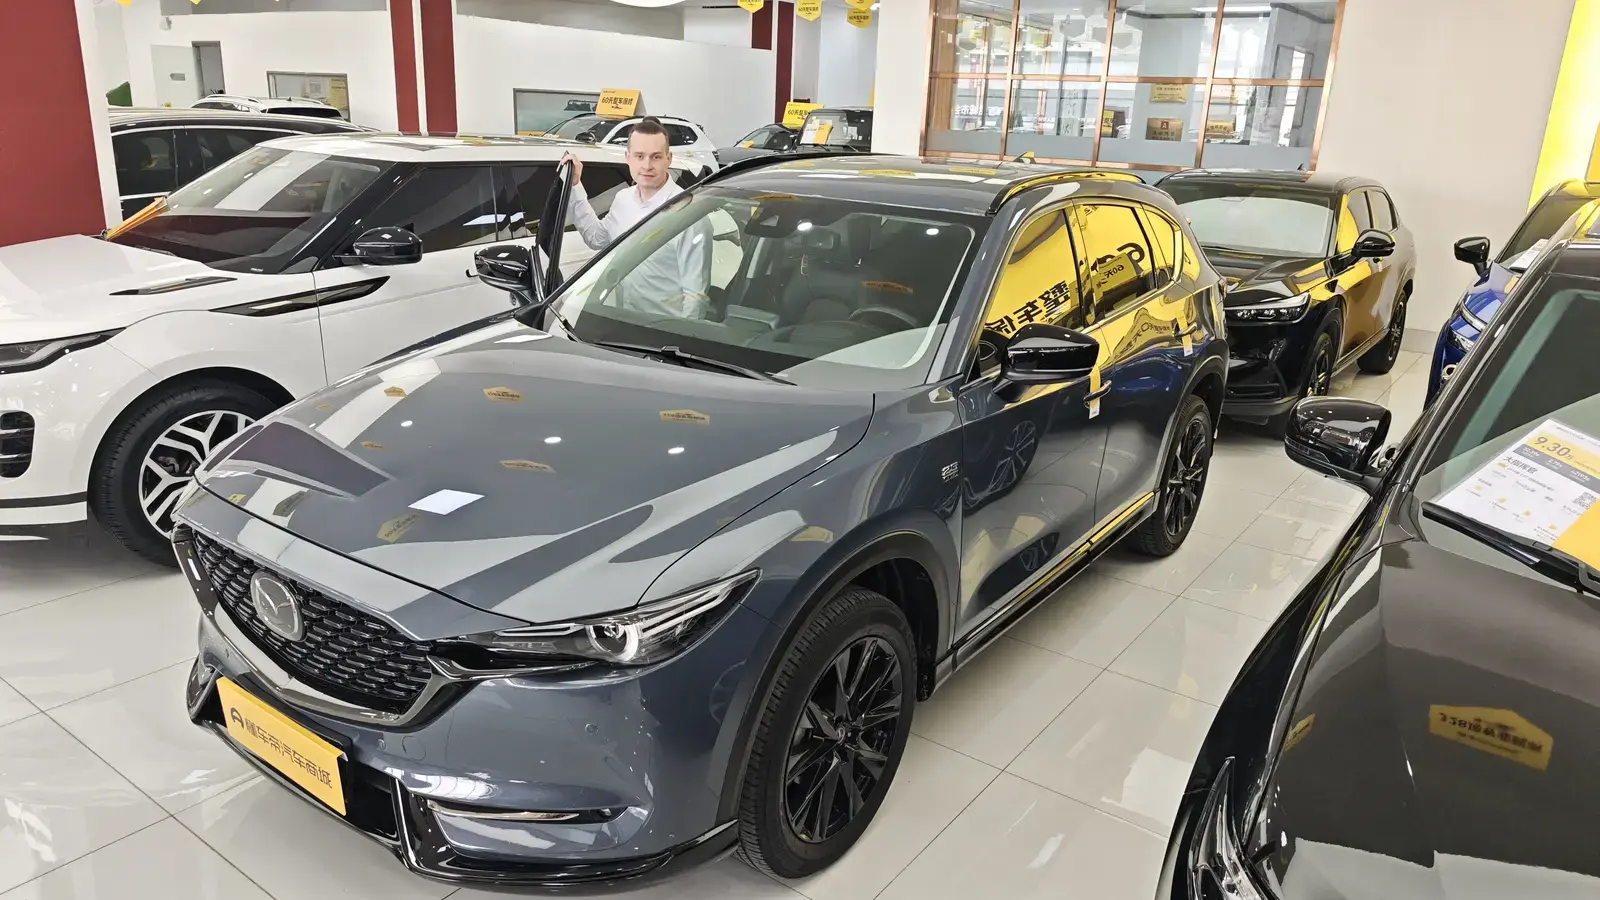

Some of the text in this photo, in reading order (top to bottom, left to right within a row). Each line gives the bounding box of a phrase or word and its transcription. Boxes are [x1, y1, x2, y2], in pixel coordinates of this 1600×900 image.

[245, 717, 333, 789] 懂车帝汽车商城
